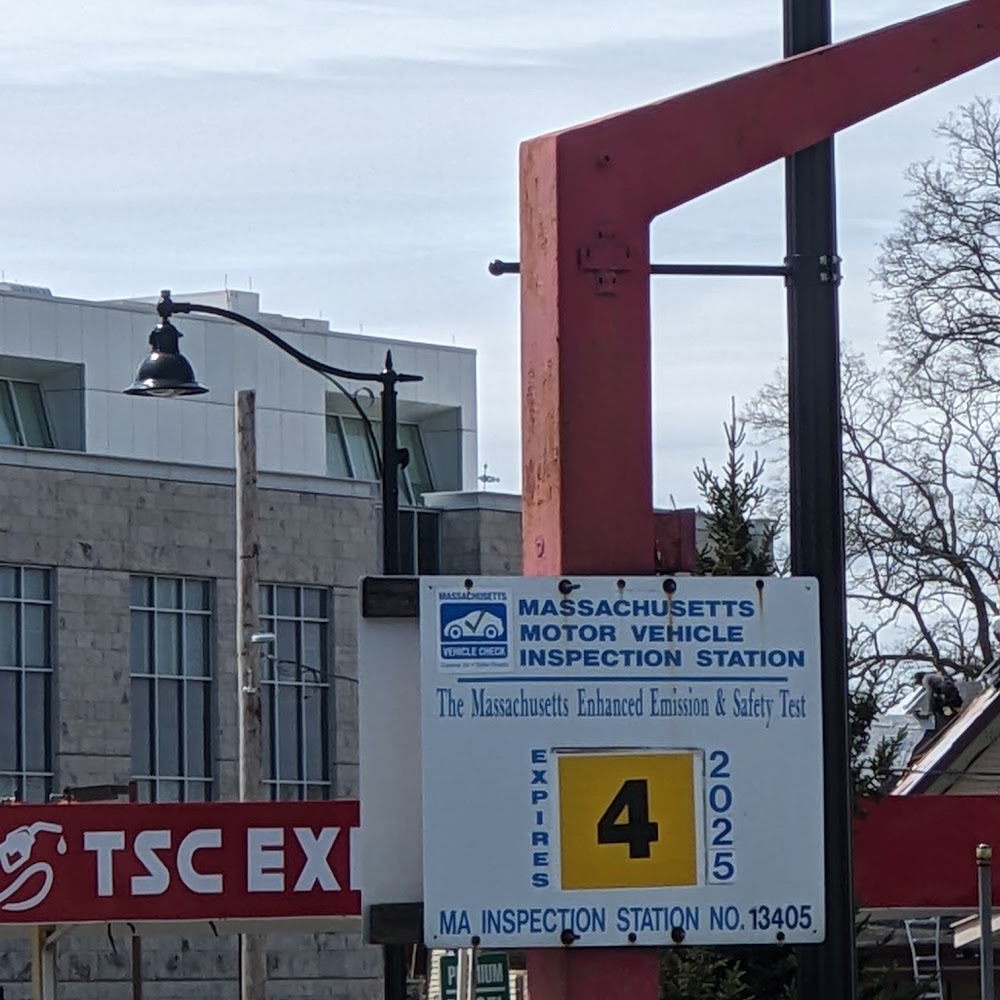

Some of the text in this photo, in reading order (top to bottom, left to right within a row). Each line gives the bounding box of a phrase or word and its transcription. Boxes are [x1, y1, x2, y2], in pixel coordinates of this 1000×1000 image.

[518, 598, 755, 618] MASSACHUSETTS
[519, 623, 744, 643] MOTOR VEHICLE
[442, 646, 507, 658] VEHICLE CHECK
[519, 648, 805, 668] INSPECTION STATION
[436, 686, 807, 729] The Massachusetts Enhanced Emission & Safety Test
[531, 749, 550, 888] EXPIRES
[597, 779, 659, 859] 4
[708, 750, 735, 881] 2025
[83, 828, 224, 897] TSC
[439, 905, 812, 935] MA INSPECTION STATION NO. 13405
